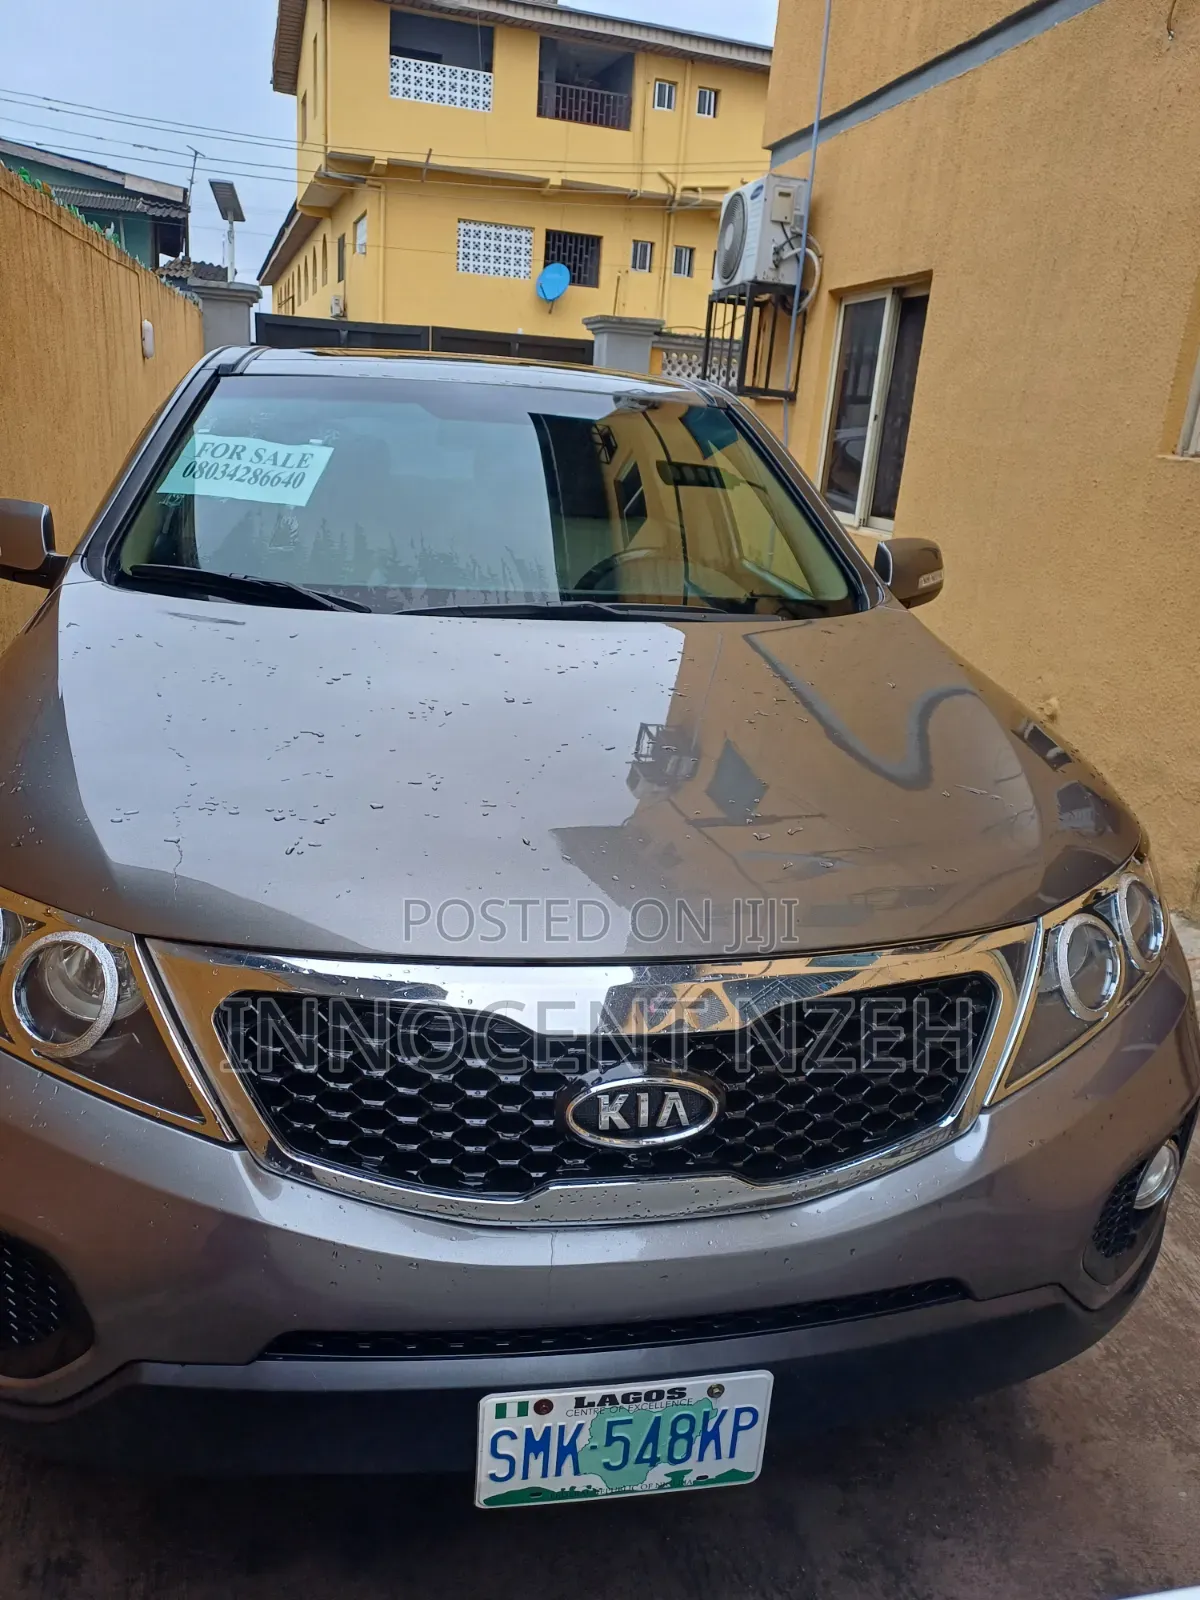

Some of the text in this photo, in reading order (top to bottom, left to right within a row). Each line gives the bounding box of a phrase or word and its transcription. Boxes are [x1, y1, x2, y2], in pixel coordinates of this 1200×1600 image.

[193, 442, 314, 469] FOR SALE
[182, 460, 306, 489] 08034286640
[596, 1091, 690, 1131] KIA
[565, 1397, 694, 1418] CENTRE OF EXCELLENCE
[574, 1386, 687, 1409] LAGOS
[487, 1404, 760, 1483] SMK-548KP
[640, 1482, 653, 1491] OF
